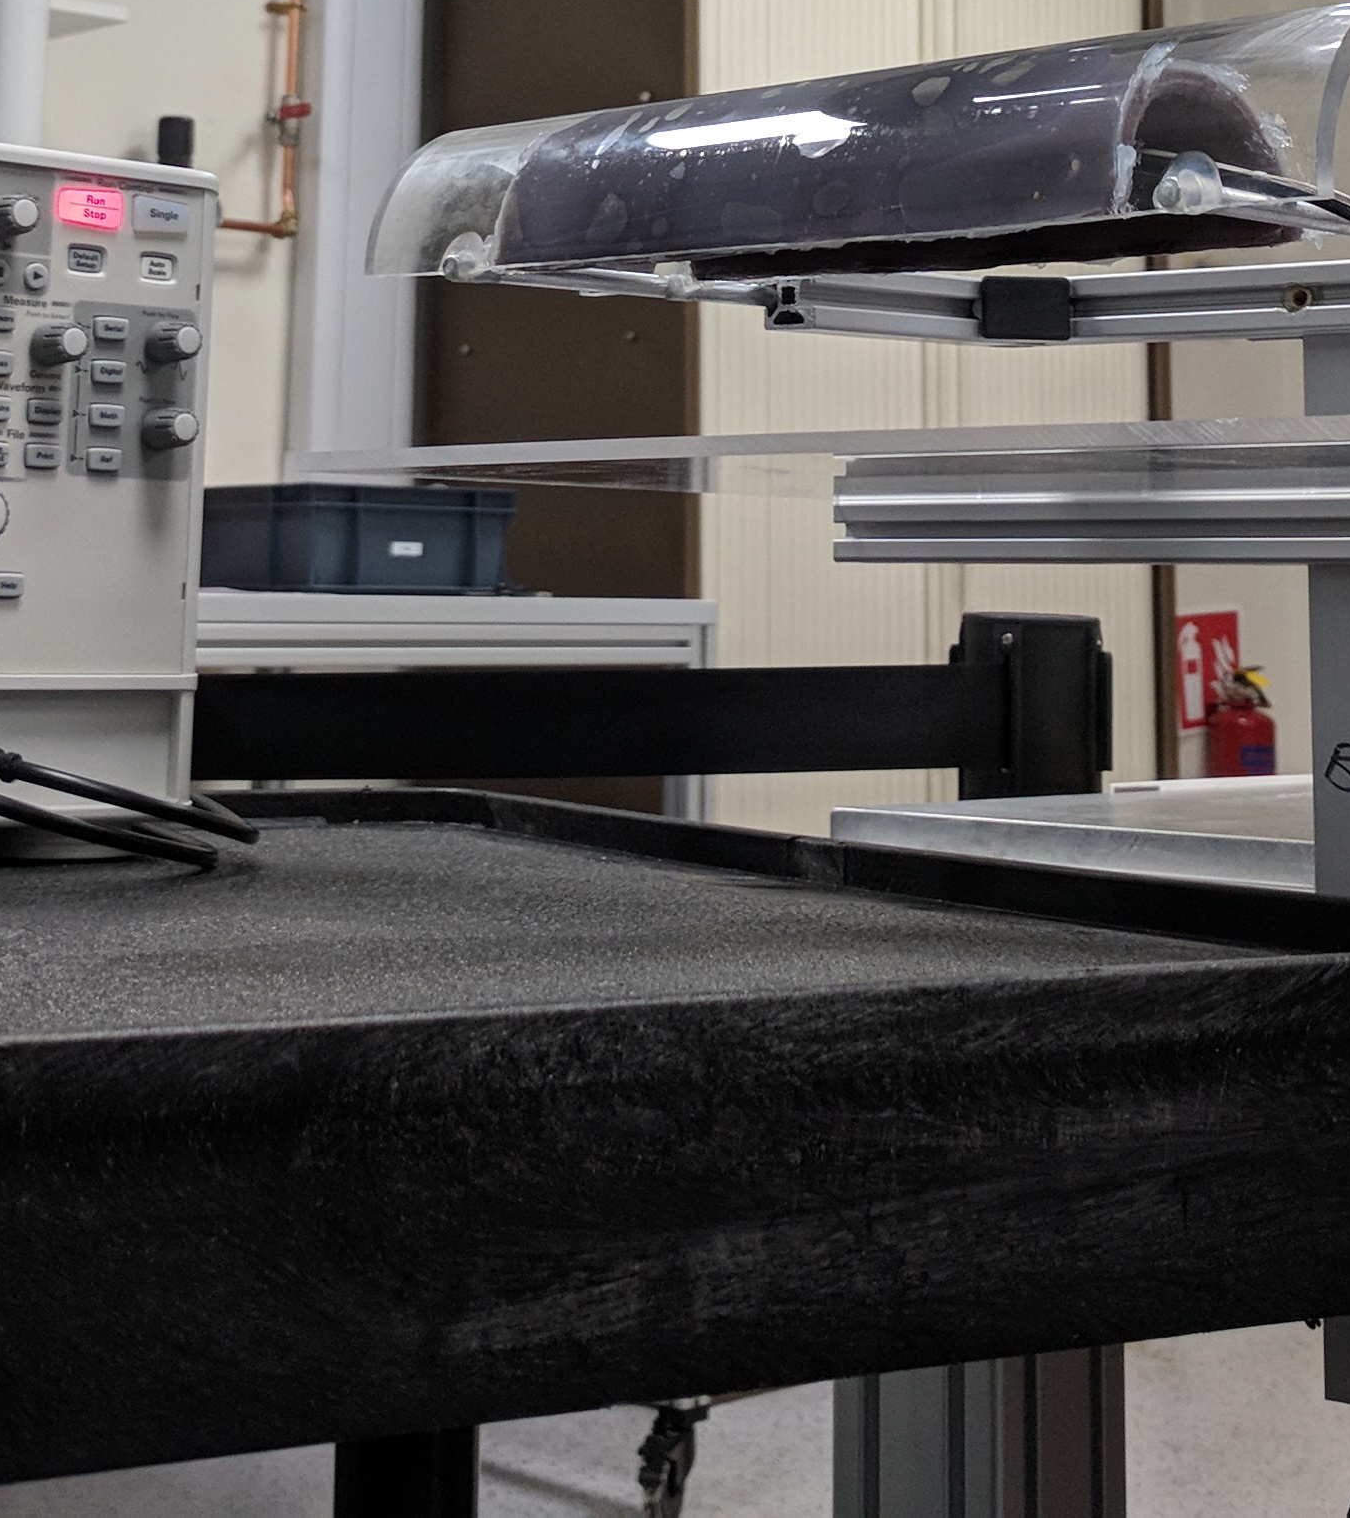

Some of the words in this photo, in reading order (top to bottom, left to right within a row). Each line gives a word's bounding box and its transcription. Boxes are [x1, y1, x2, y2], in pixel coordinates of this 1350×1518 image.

[87, 195, 105, 206] Run
[84, 209, 107, 220] Stop
[150, 208, 178, 221] Single
[150, 260, 165, 268] Auto
[3, 295, 47, 308] Measure
[7, 429, 25, 439] File
